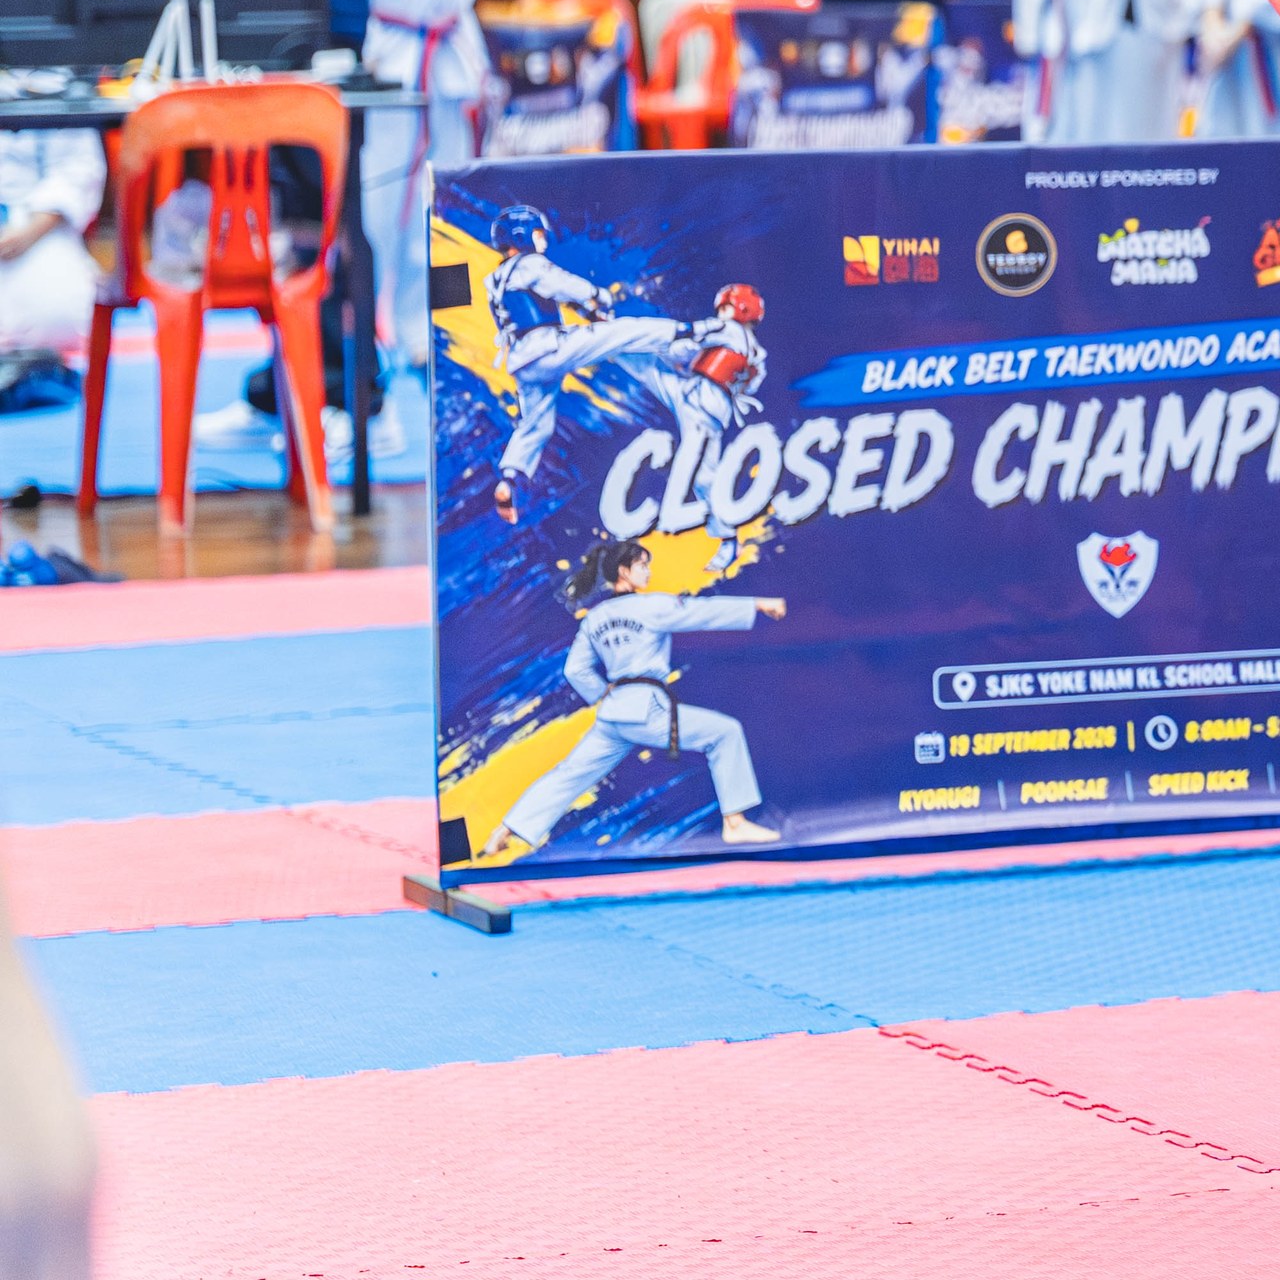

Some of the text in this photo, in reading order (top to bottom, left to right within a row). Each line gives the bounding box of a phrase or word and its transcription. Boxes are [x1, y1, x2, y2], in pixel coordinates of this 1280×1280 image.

[1025, 168, 1219, 189] PROUDLY SPONSORED BY
[882, 237, 940, 256] YIHAI
[862, 356, 958, 393] BLACK
[964, 348, 1038, 386] BELT
[1044, 333, 1220, 379] TAEKWONDO
[599, 408, 955, 541] CLOSED
[985, 673, 1034, 698] SJKC
[1037, 669, 1087, 695] YOKE
[1089, 667, 1134, 692] NAM
[1136, 666, 1161, 689] KL
[1164, 662, 1237, 688] SCHOOL
[972, 728, 1071, 755] SEPTEMBER
[899, 785, 981, 812] KYORUGI
[1020, 777, 1109, 804] POOMSAE
[1148, 771, 1205, 796] SPEED
[1206, 768, 1250, 793] KICK
